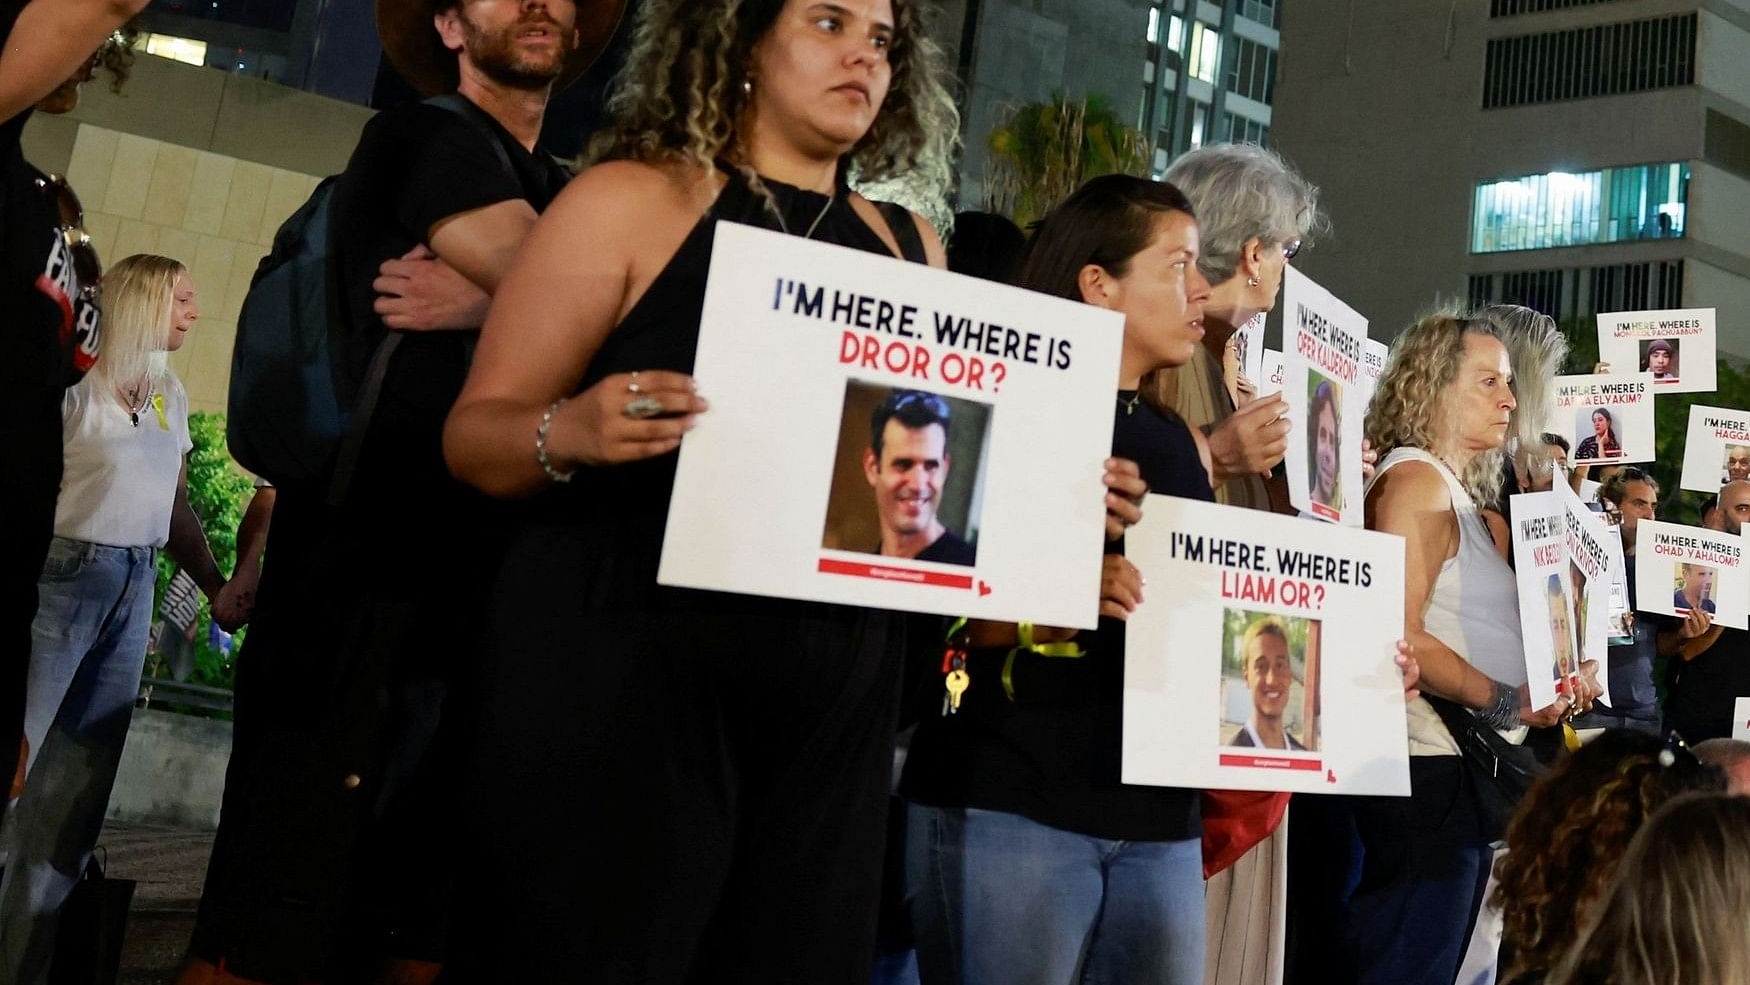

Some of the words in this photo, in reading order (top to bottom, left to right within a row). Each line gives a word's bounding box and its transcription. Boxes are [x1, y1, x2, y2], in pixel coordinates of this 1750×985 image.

[773, 278, 824, 319] I'M
[831, 290, 922, 339] HERE.
[934, 312, 1041, 364] WHERE
[1047, 337, 1072, 370] IS
[1297, 302, 1308, 329] I'M
[1330, 322, 1354, 357] WHERE
[1355, 339, 1360, 362] IS
[839, 330, 930, 380] DROR
[1297, 330, 1318, 363] OFER
[1317, 343, 1358, 386] KALDERON?
[1703, 417, 1719, 428] I'M
[1171, 532, 1203, 563] I'M
[1209, 538, 1271, 572] HERE.
[1277, 548, 1350, 584] WHERE
[1355, 561, 1372, 587] IS
[1654, 533, 1670, 545] I'M
[1699, 541, 1732, 555] WHERE
[1732, 546, 1741, 556] IS
[1654, 545, 1684, 559] OHAD
[1686, 550, 1740, 567] YAHALOMI?
[1221, 570, 1275, 604] LIAM
